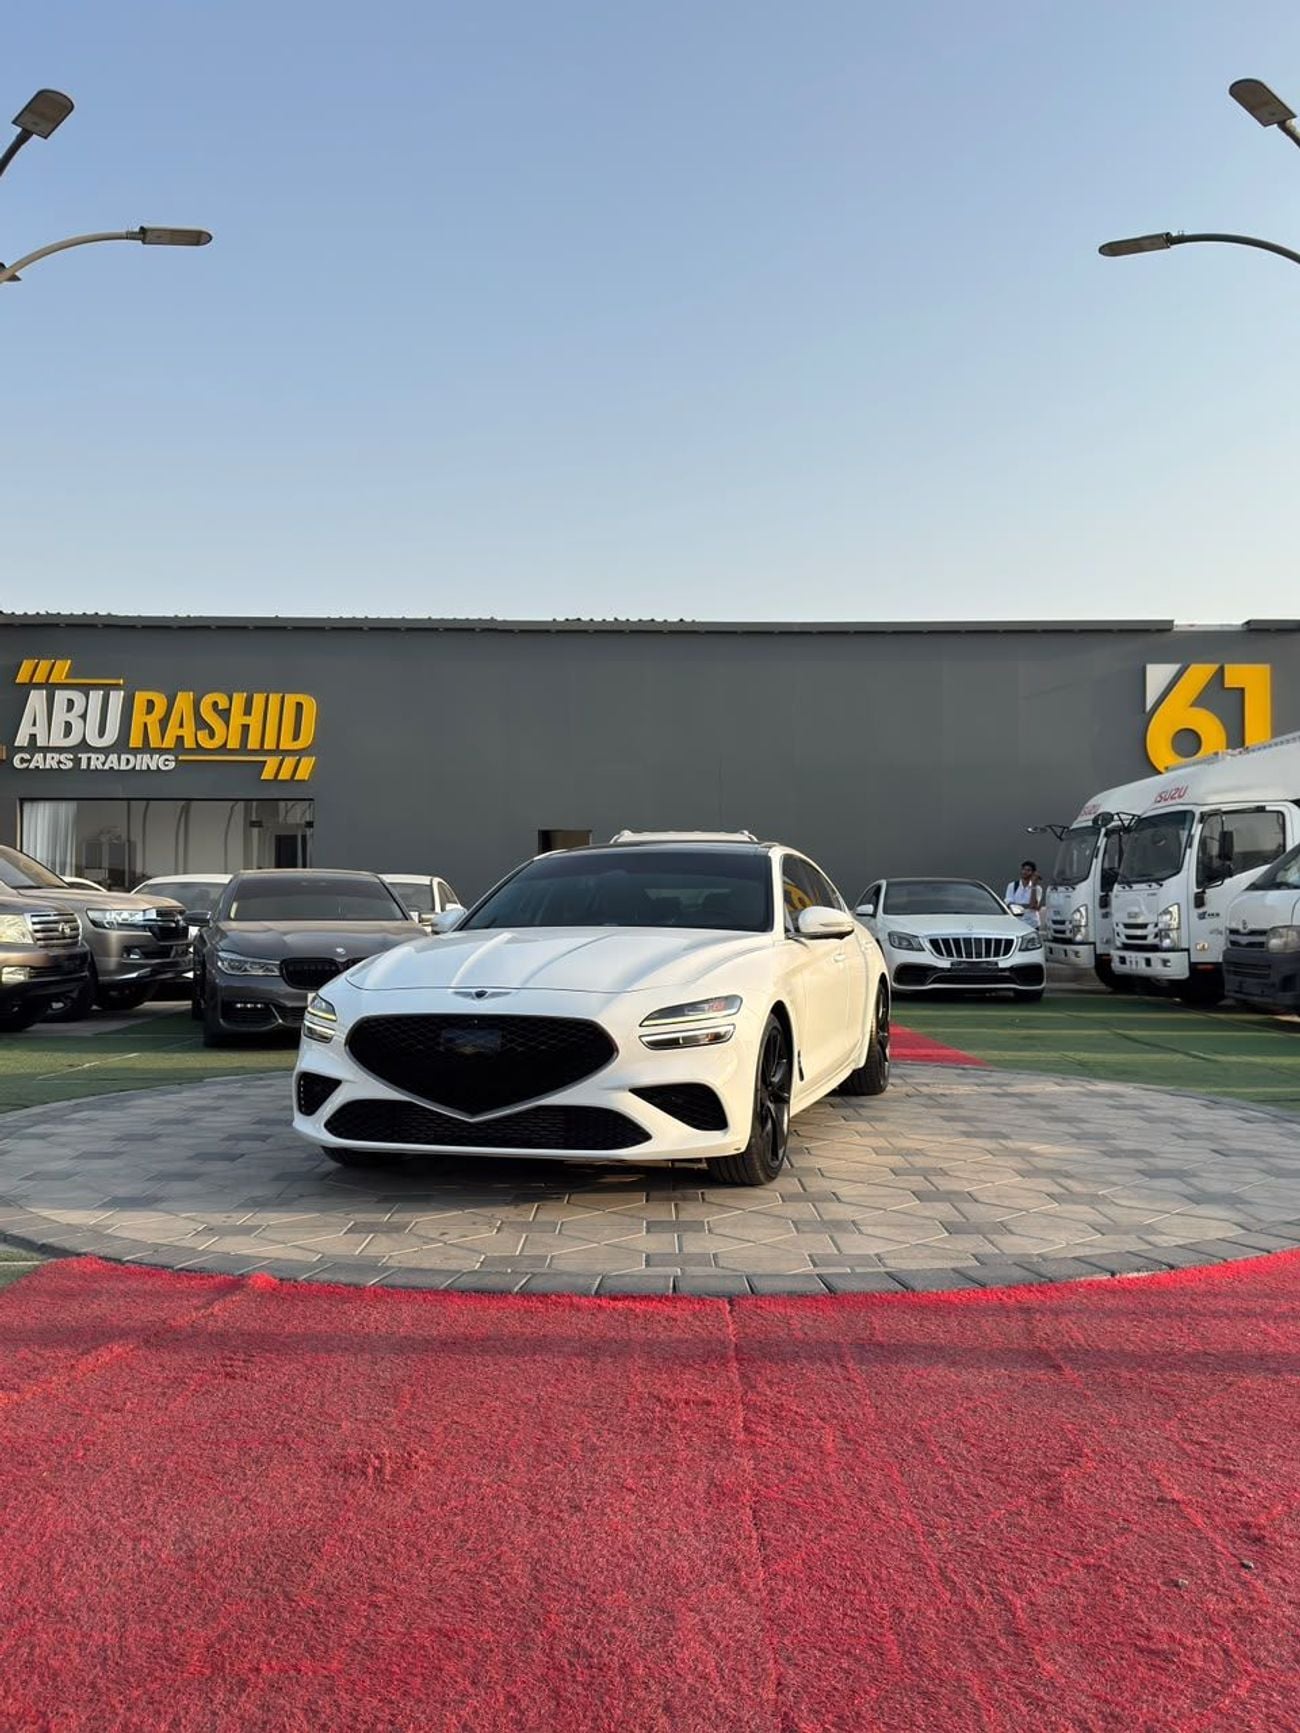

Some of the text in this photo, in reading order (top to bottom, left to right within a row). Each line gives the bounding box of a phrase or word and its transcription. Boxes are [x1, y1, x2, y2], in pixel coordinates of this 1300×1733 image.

[14, 689, 317, 750] ABU RASHID
[1146, 664, 1271, 774] 61
[13, 753, 176, 770] CARS TRADING
[1155, 786, 1188, 803] ISUZU
